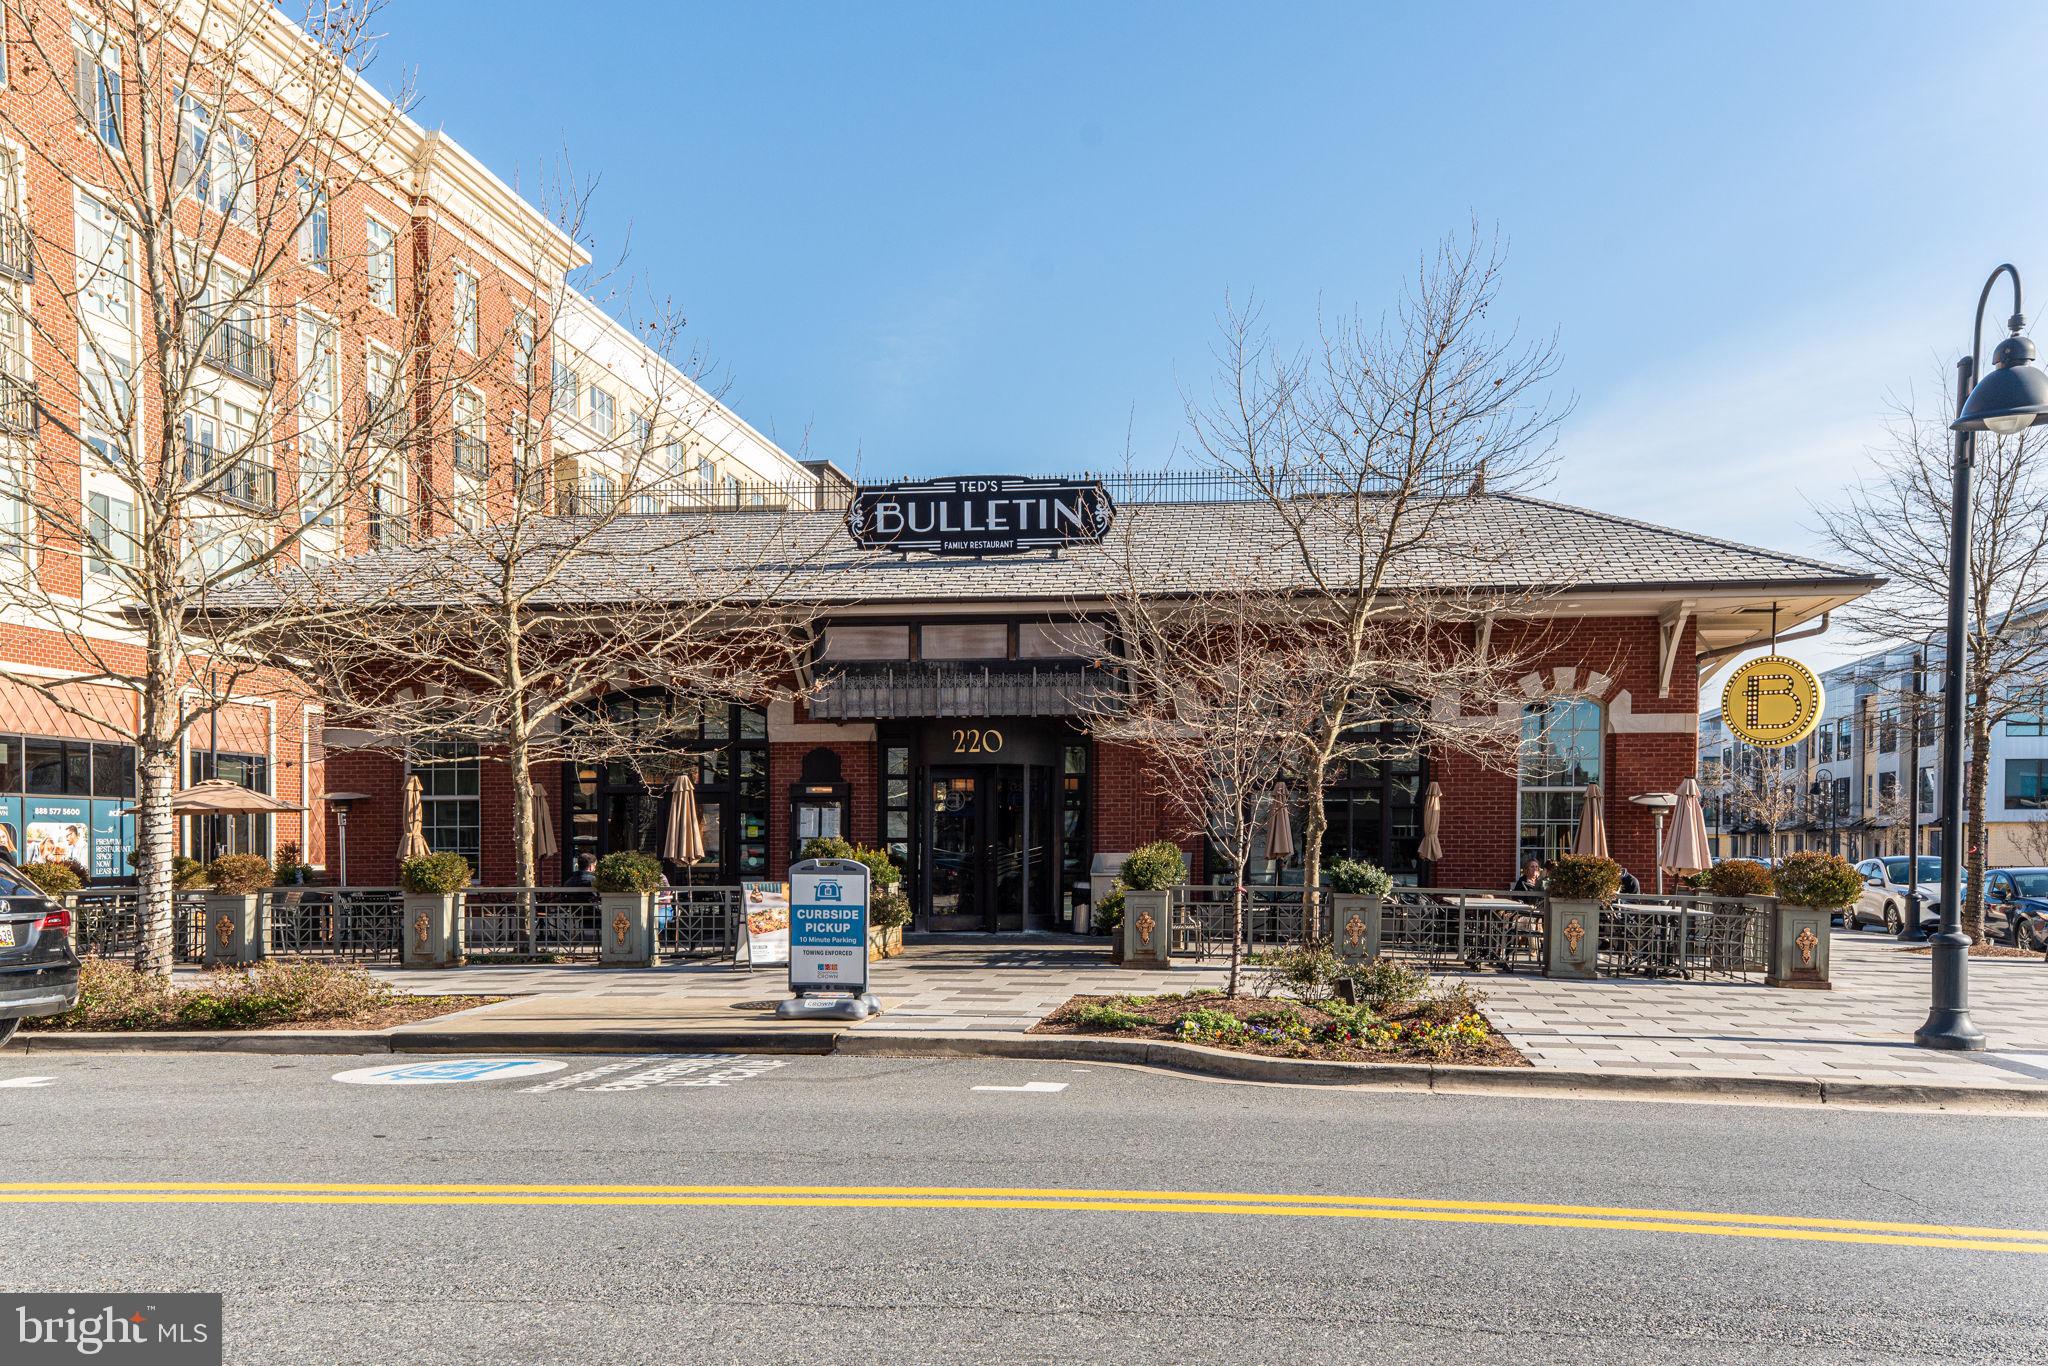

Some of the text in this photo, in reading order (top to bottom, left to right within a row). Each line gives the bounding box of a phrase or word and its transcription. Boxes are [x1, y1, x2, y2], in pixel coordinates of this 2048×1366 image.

[959, 480, 999, 493] TED'S
[874, 498, 1083, 533] BULLETIN
[944, 540, 1014, 550] FAMILY RESTAURANT
[1742, 674, 1802, 729] B
[952, 729, 1003, 753] 220
[34, 807, 80, 816] 888 577 5600
[95, 860, 111, 868] NOW
[796, 909, 859, 920] CURBSIDE
[805, 923, 851, 933] PICKUP
